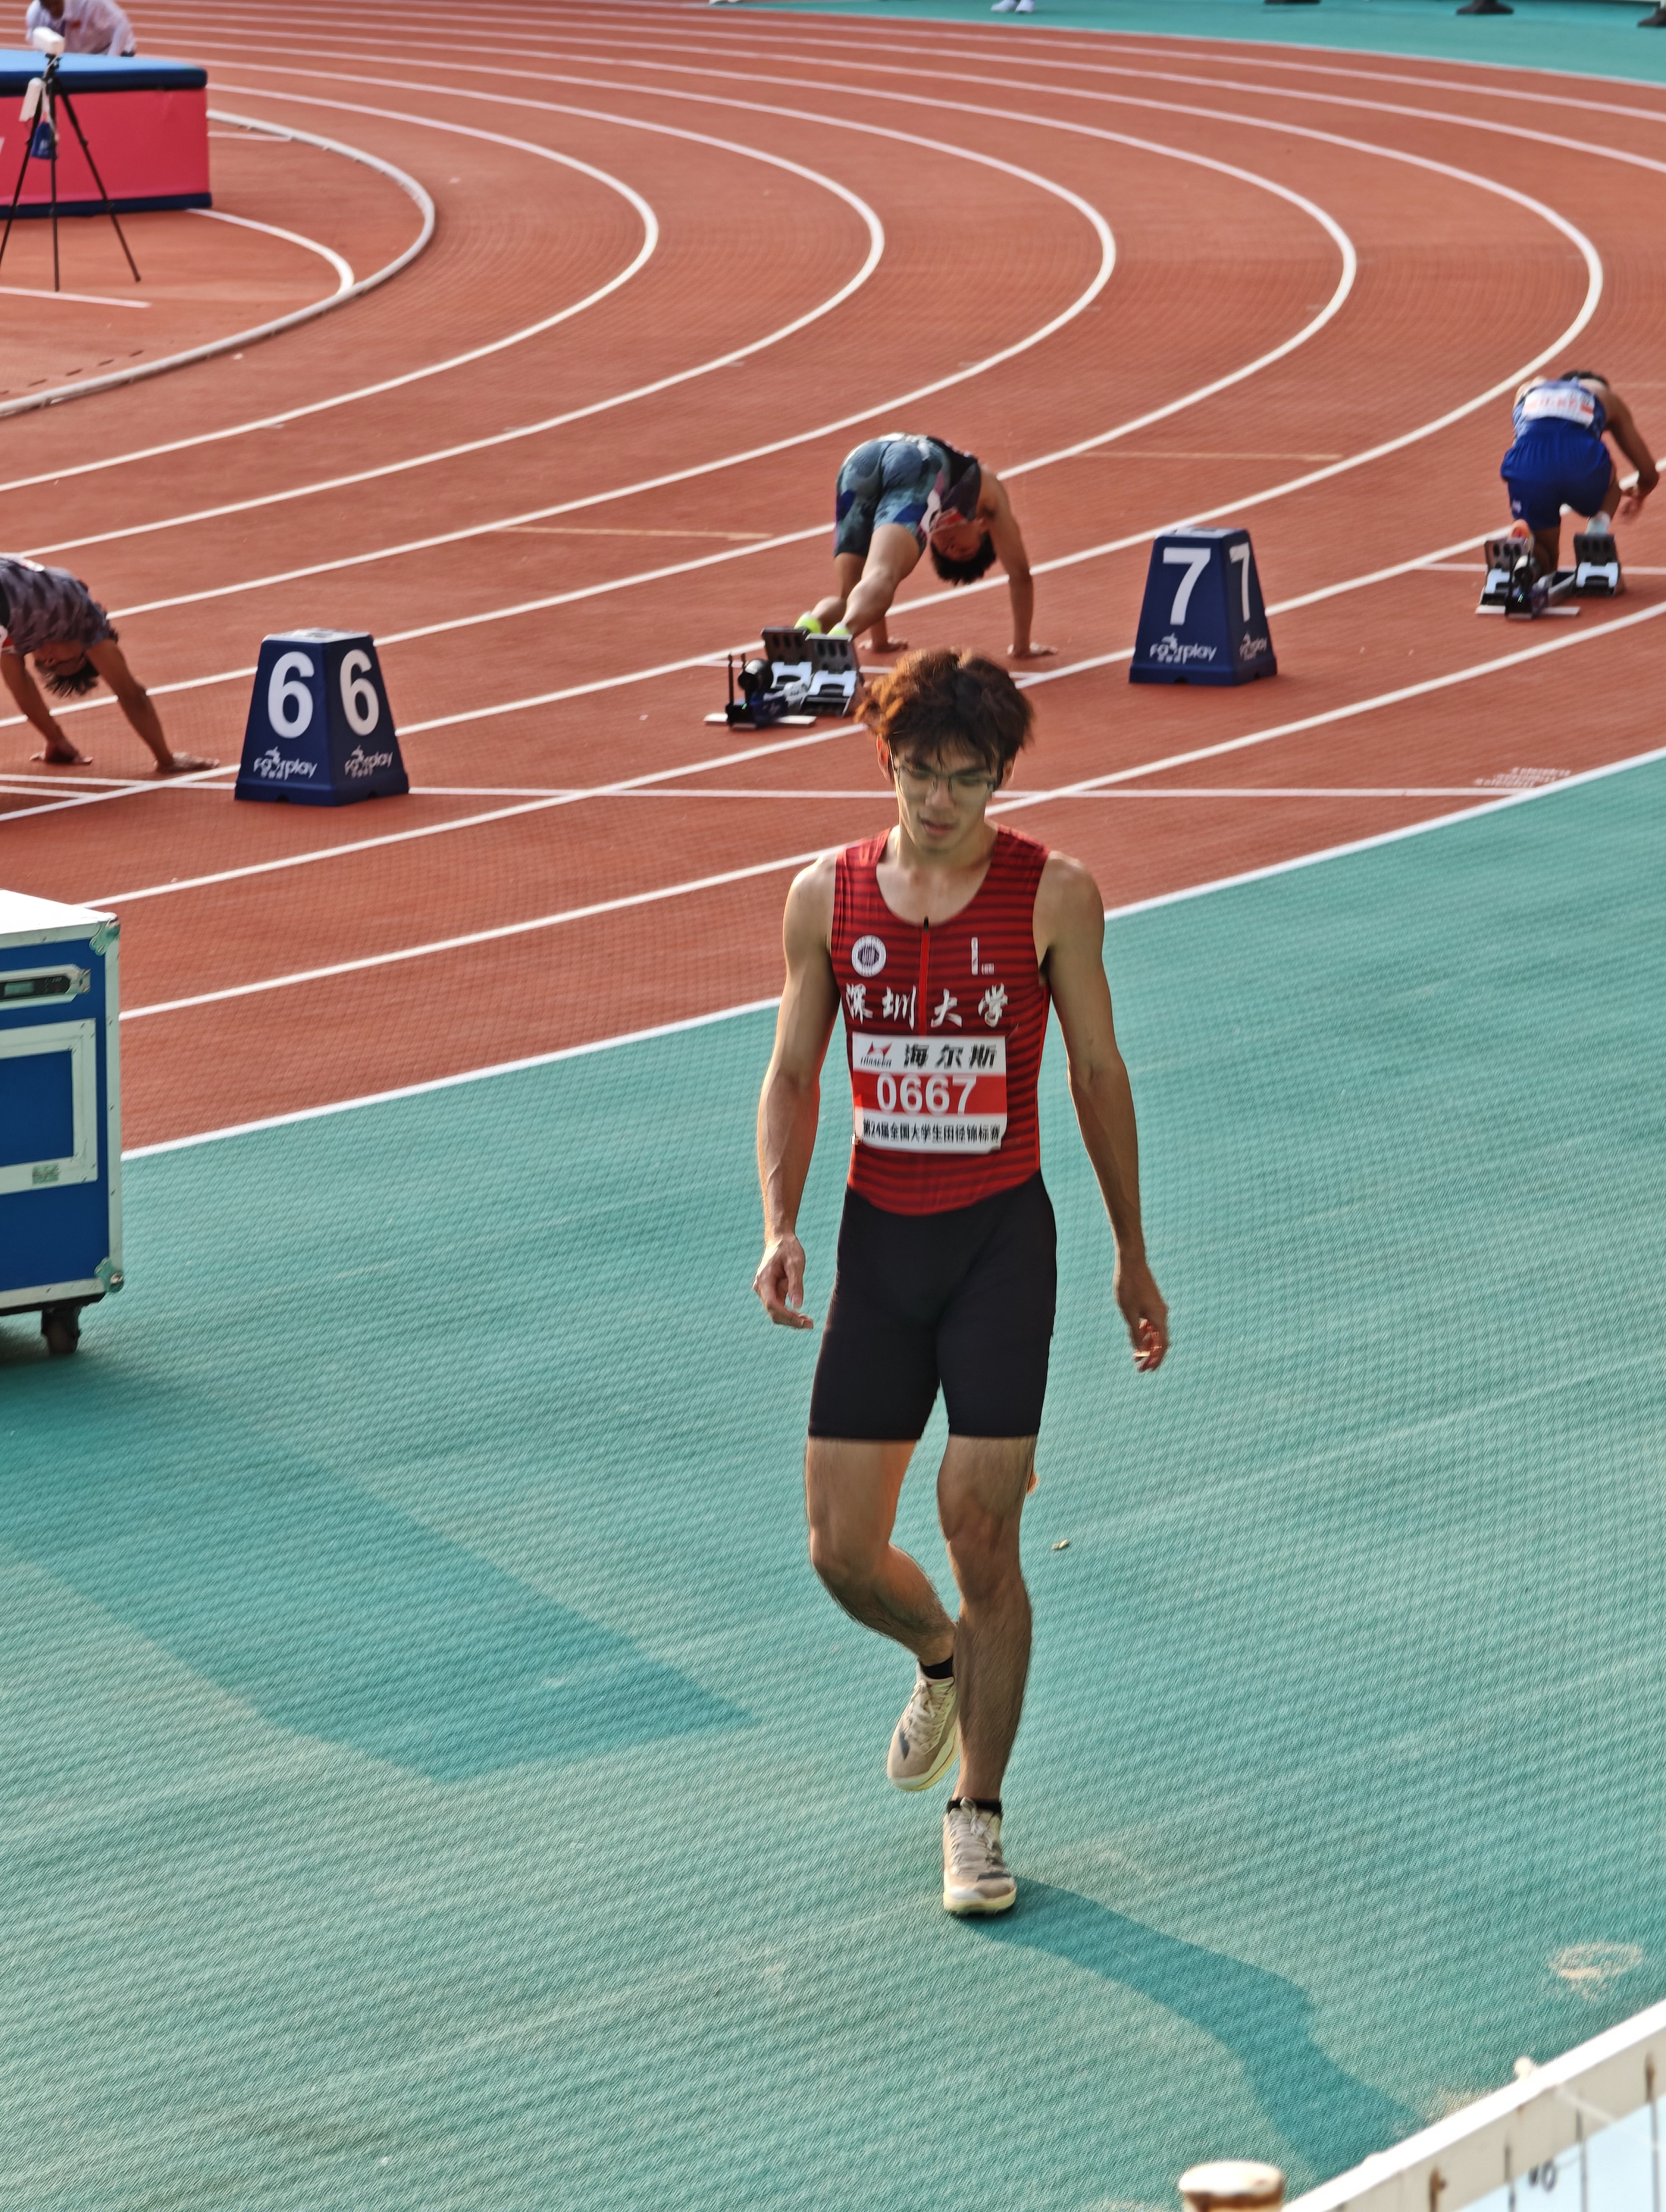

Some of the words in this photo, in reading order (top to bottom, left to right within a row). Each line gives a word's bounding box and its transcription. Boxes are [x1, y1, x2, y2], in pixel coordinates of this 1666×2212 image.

[1163, 548, 1211, 626] 7
[1229, 542, 1251, 623] 7
[268, 651, 315, 739] 6
[339, 649, 380, 737] 6
[846, 983, 1008, 1030] 深圳大学
[876, 1073, 977, 1116] 0667
[904, 1043, 997, 1069] 海尔斯
